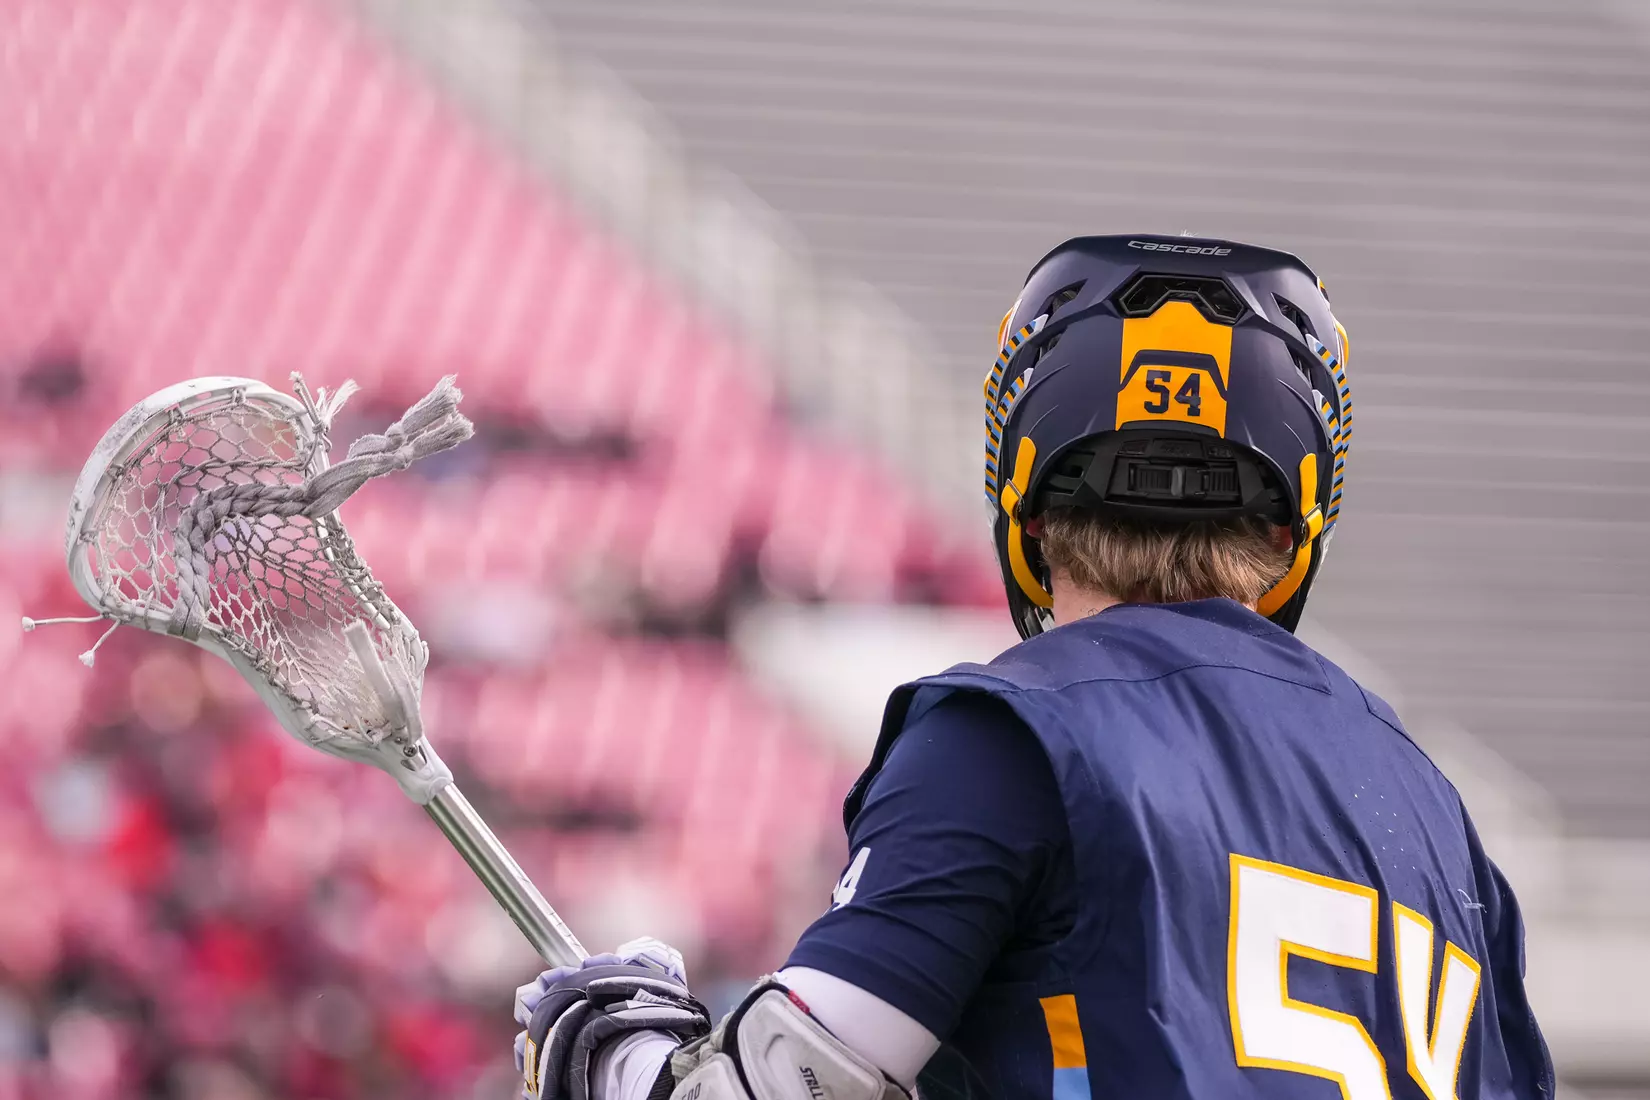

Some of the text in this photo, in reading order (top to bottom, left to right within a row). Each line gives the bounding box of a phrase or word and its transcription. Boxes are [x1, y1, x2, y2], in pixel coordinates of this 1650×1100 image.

[1127, 240, 1232, 256] cascade
[1144, 369, 1201, 416] 54
[828, 846, 872, 912] 4
